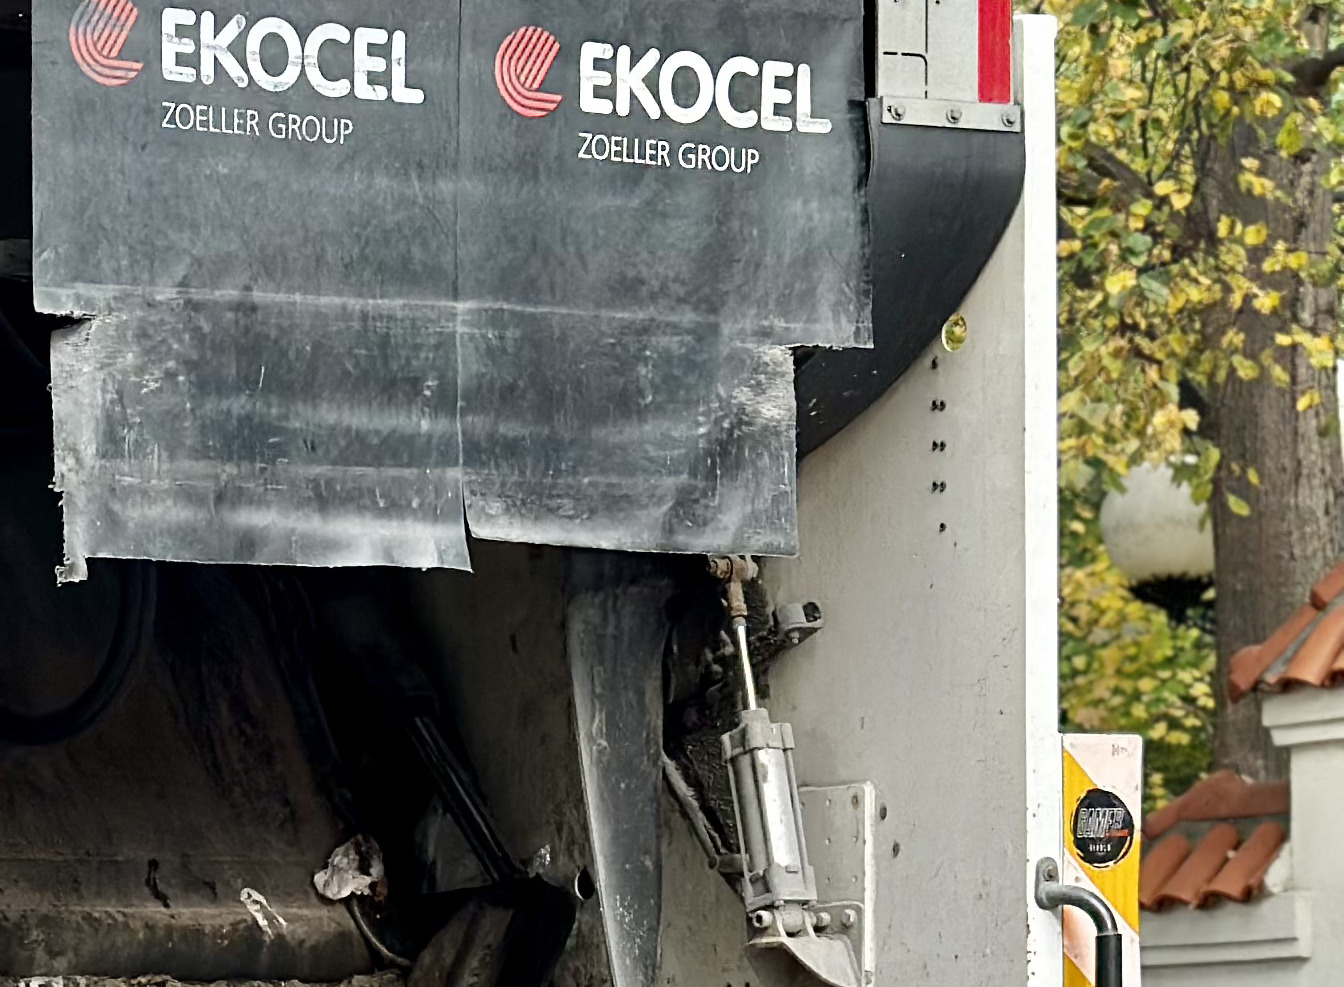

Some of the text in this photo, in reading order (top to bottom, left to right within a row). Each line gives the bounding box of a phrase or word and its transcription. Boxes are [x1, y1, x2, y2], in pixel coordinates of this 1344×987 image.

[161, 7, 425, 104] EKOCEL
[579, 41, 833, 134] EKOCEL
[161, 102, 354, 145] ZOELLER GROUP
[577, 132, 760, 174] ZOELLER GROUP
